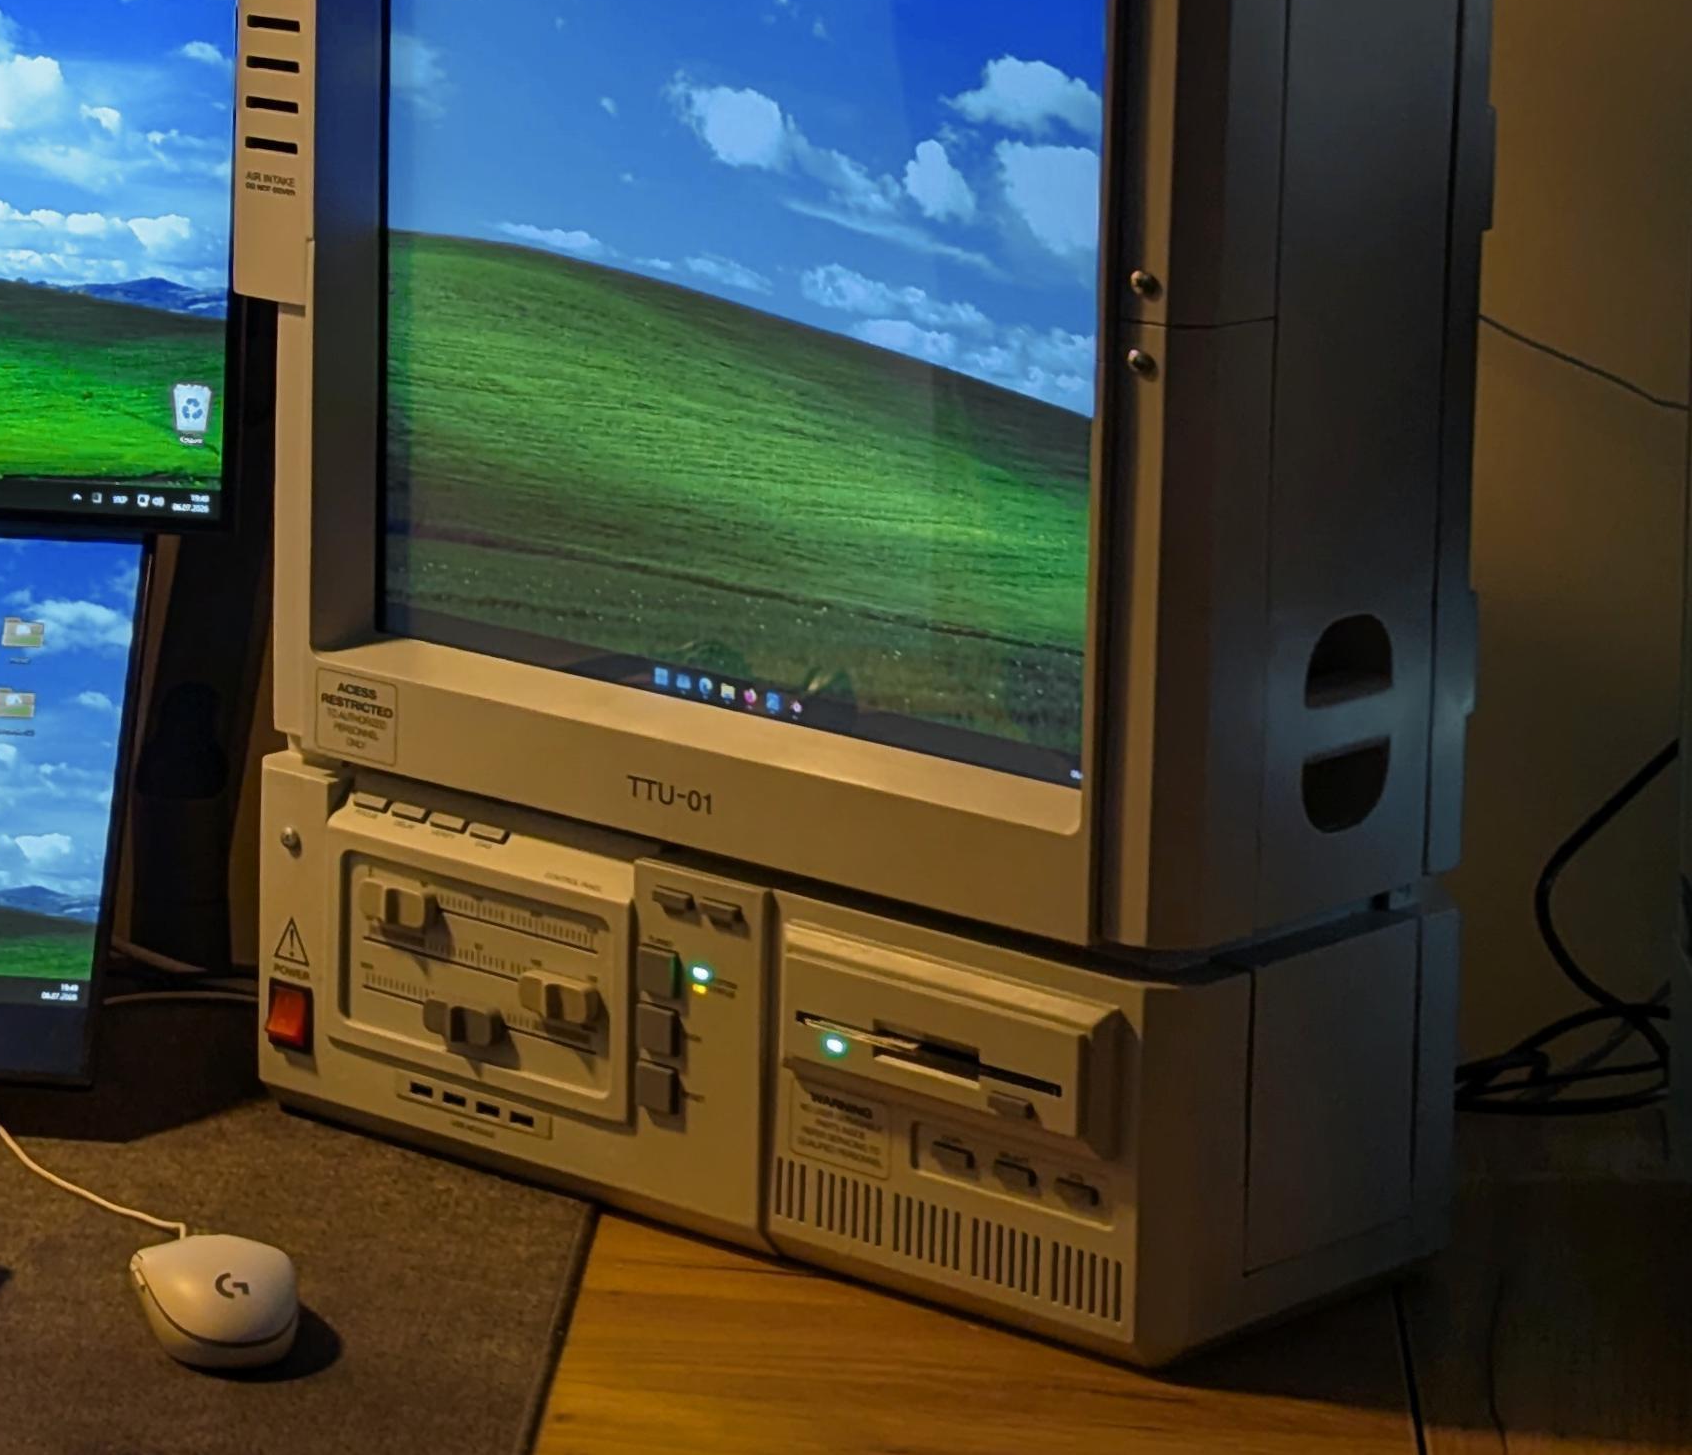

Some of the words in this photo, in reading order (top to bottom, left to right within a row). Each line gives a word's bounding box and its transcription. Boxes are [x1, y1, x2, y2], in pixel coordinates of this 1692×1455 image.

[245, 170, 261, 182] AIR
[263, 174, 295, 188] INTAKE
[337, 682, 377, 700] ACESS
[321, 693, 393, 719] RESTRICTED
[627, 774, 712, 815] TTU-01
[274, 963, 310, 980] POWER
[809, 1091, 873, 1120] WARNING
